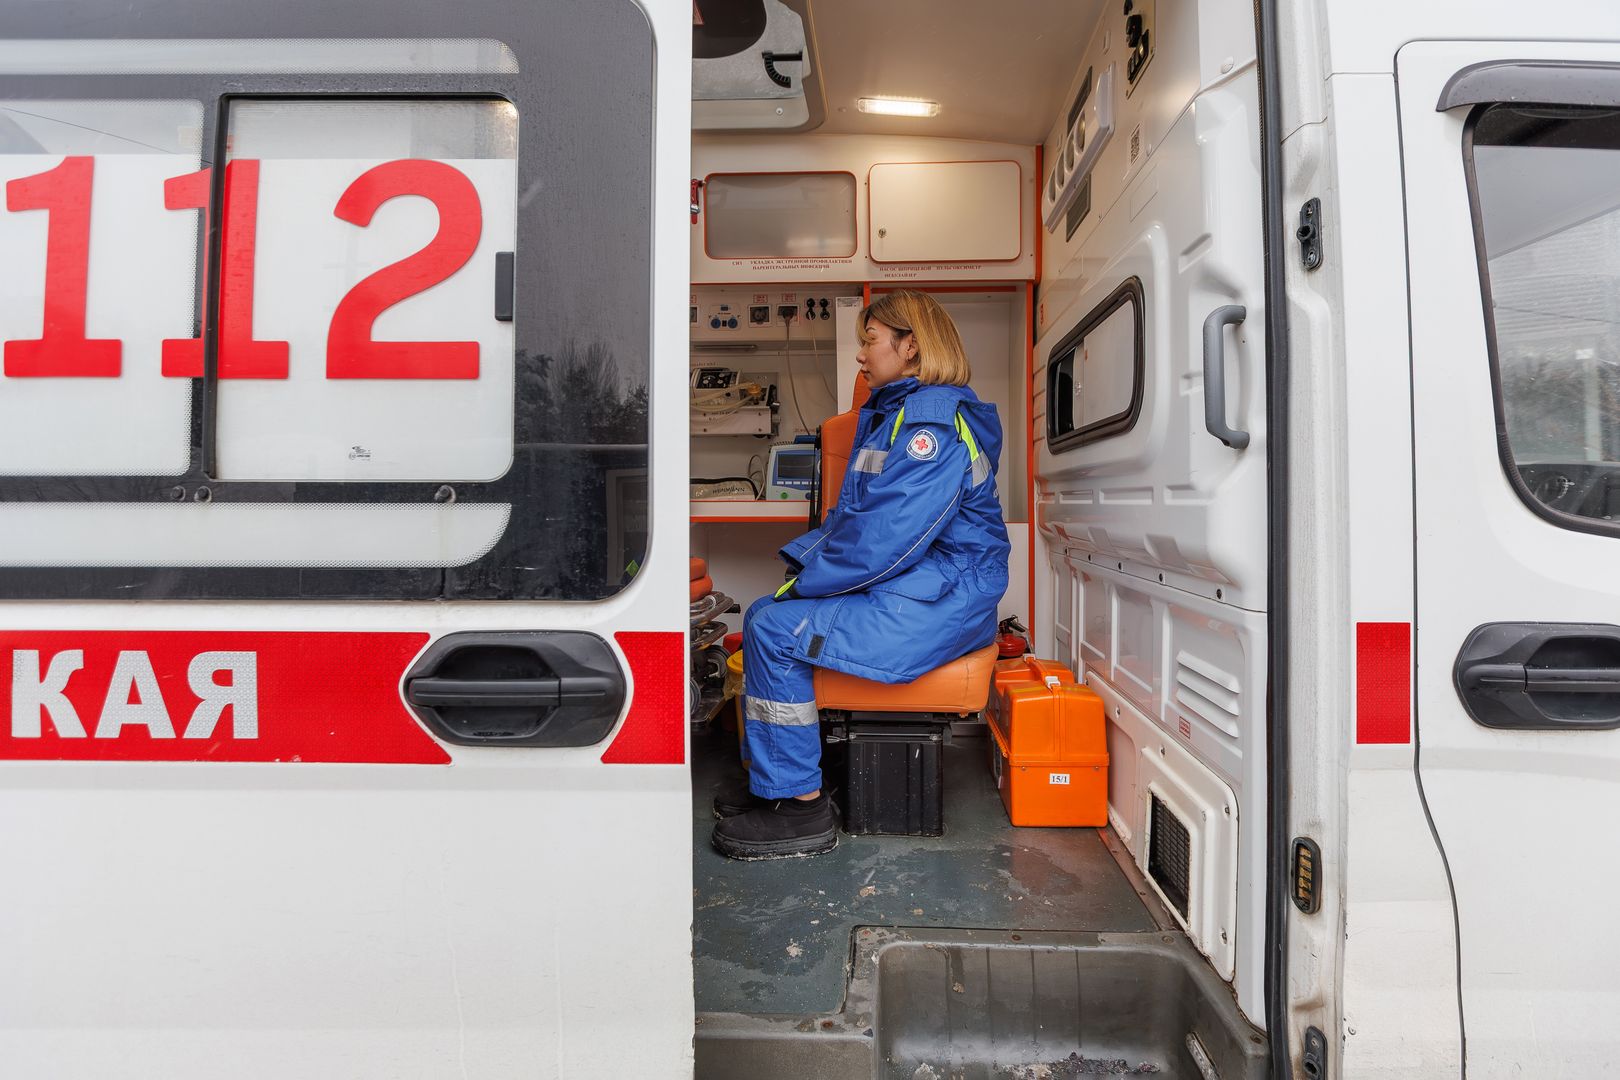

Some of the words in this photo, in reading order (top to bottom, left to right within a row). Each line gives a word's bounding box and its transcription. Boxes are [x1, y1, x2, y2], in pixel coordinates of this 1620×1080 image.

[3, 154, 483, 380] 112
[11, 649, 259, 740] КАЯ
[1052, 775, 1067, 783] 15/1
